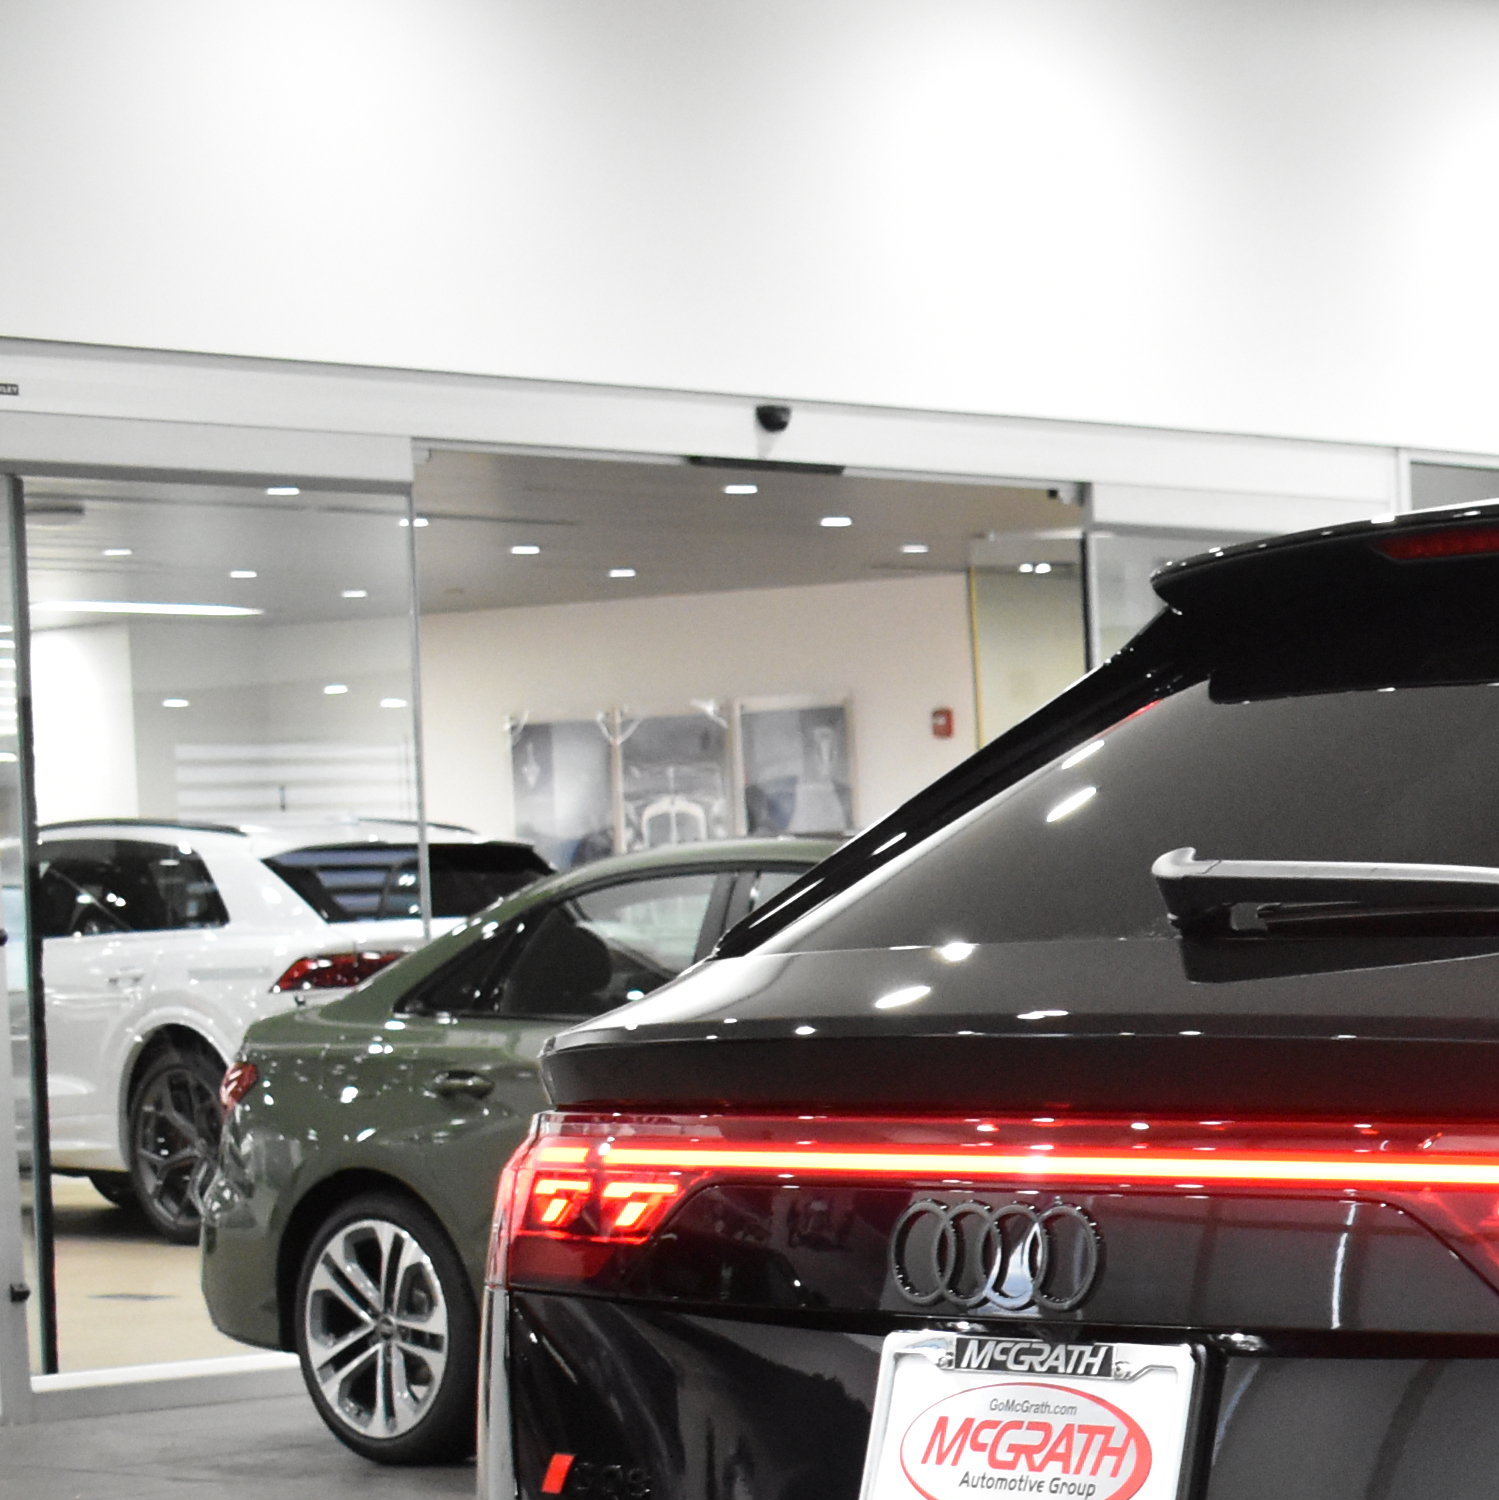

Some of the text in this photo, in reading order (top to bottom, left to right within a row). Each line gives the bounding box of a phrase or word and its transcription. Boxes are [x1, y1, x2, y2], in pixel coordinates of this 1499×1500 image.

[989, 1398, 1077, 1416] GoMcGrath.com
[959, 1471, 1096, 1500] Automotive Group
